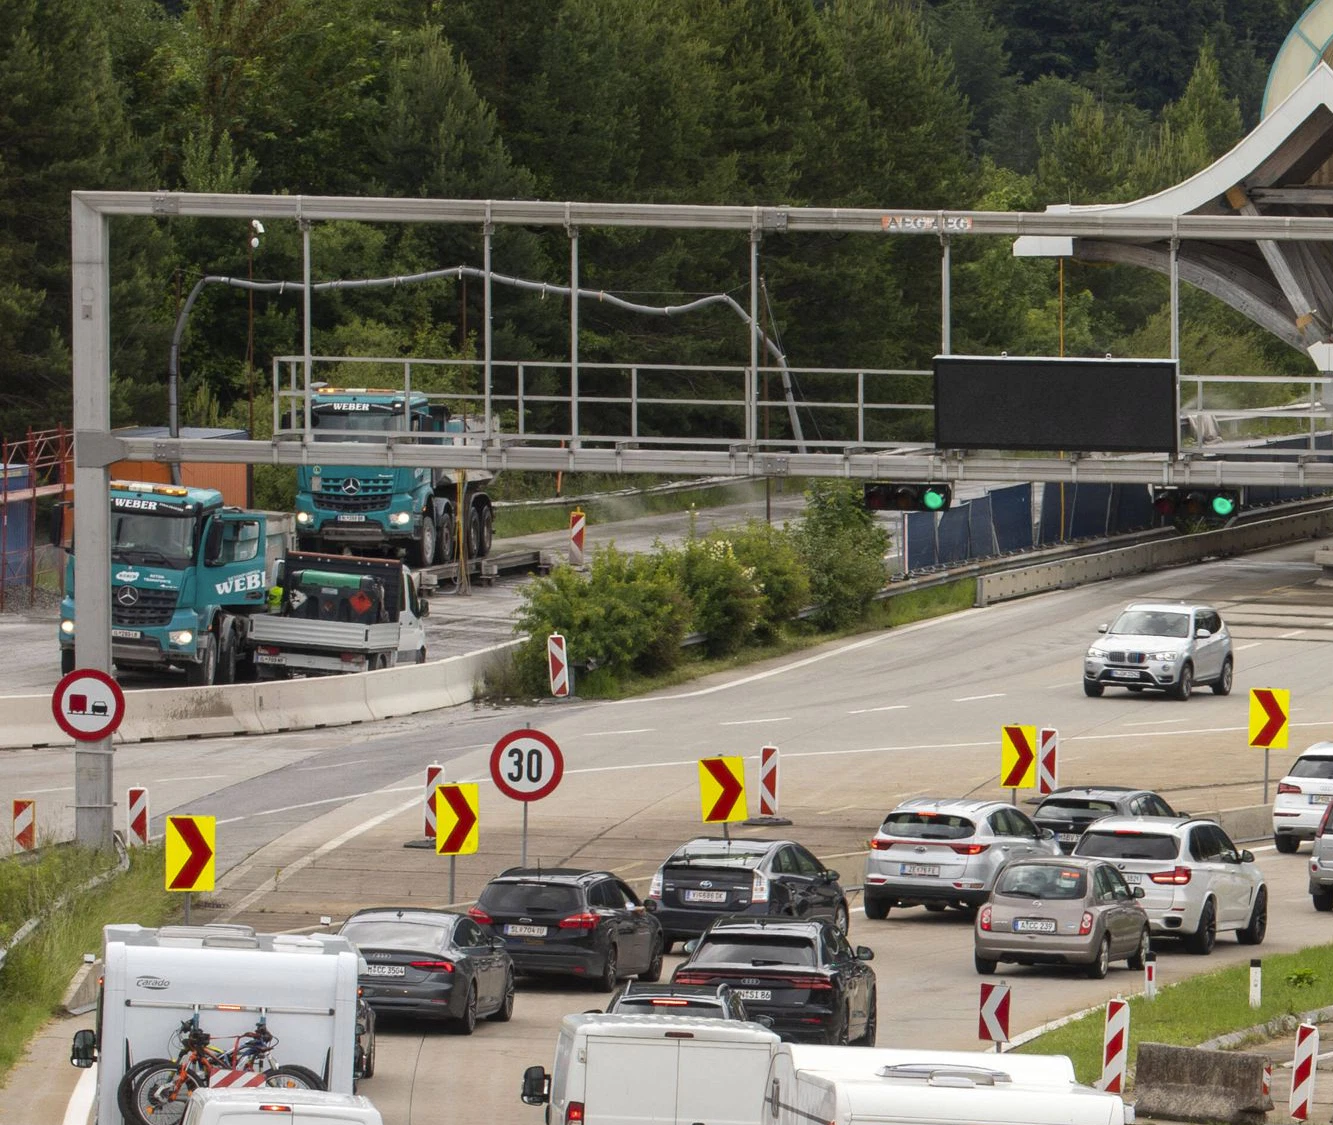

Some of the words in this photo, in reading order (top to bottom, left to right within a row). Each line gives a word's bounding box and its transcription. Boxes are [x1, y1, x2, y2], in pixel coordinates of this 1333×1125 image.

[333, 403, 370, 411] WEBER
[115, 498, 158, 510] WEBER
[508, 748, 542, 782] 30
[136, 977, 171, 988] Carado
